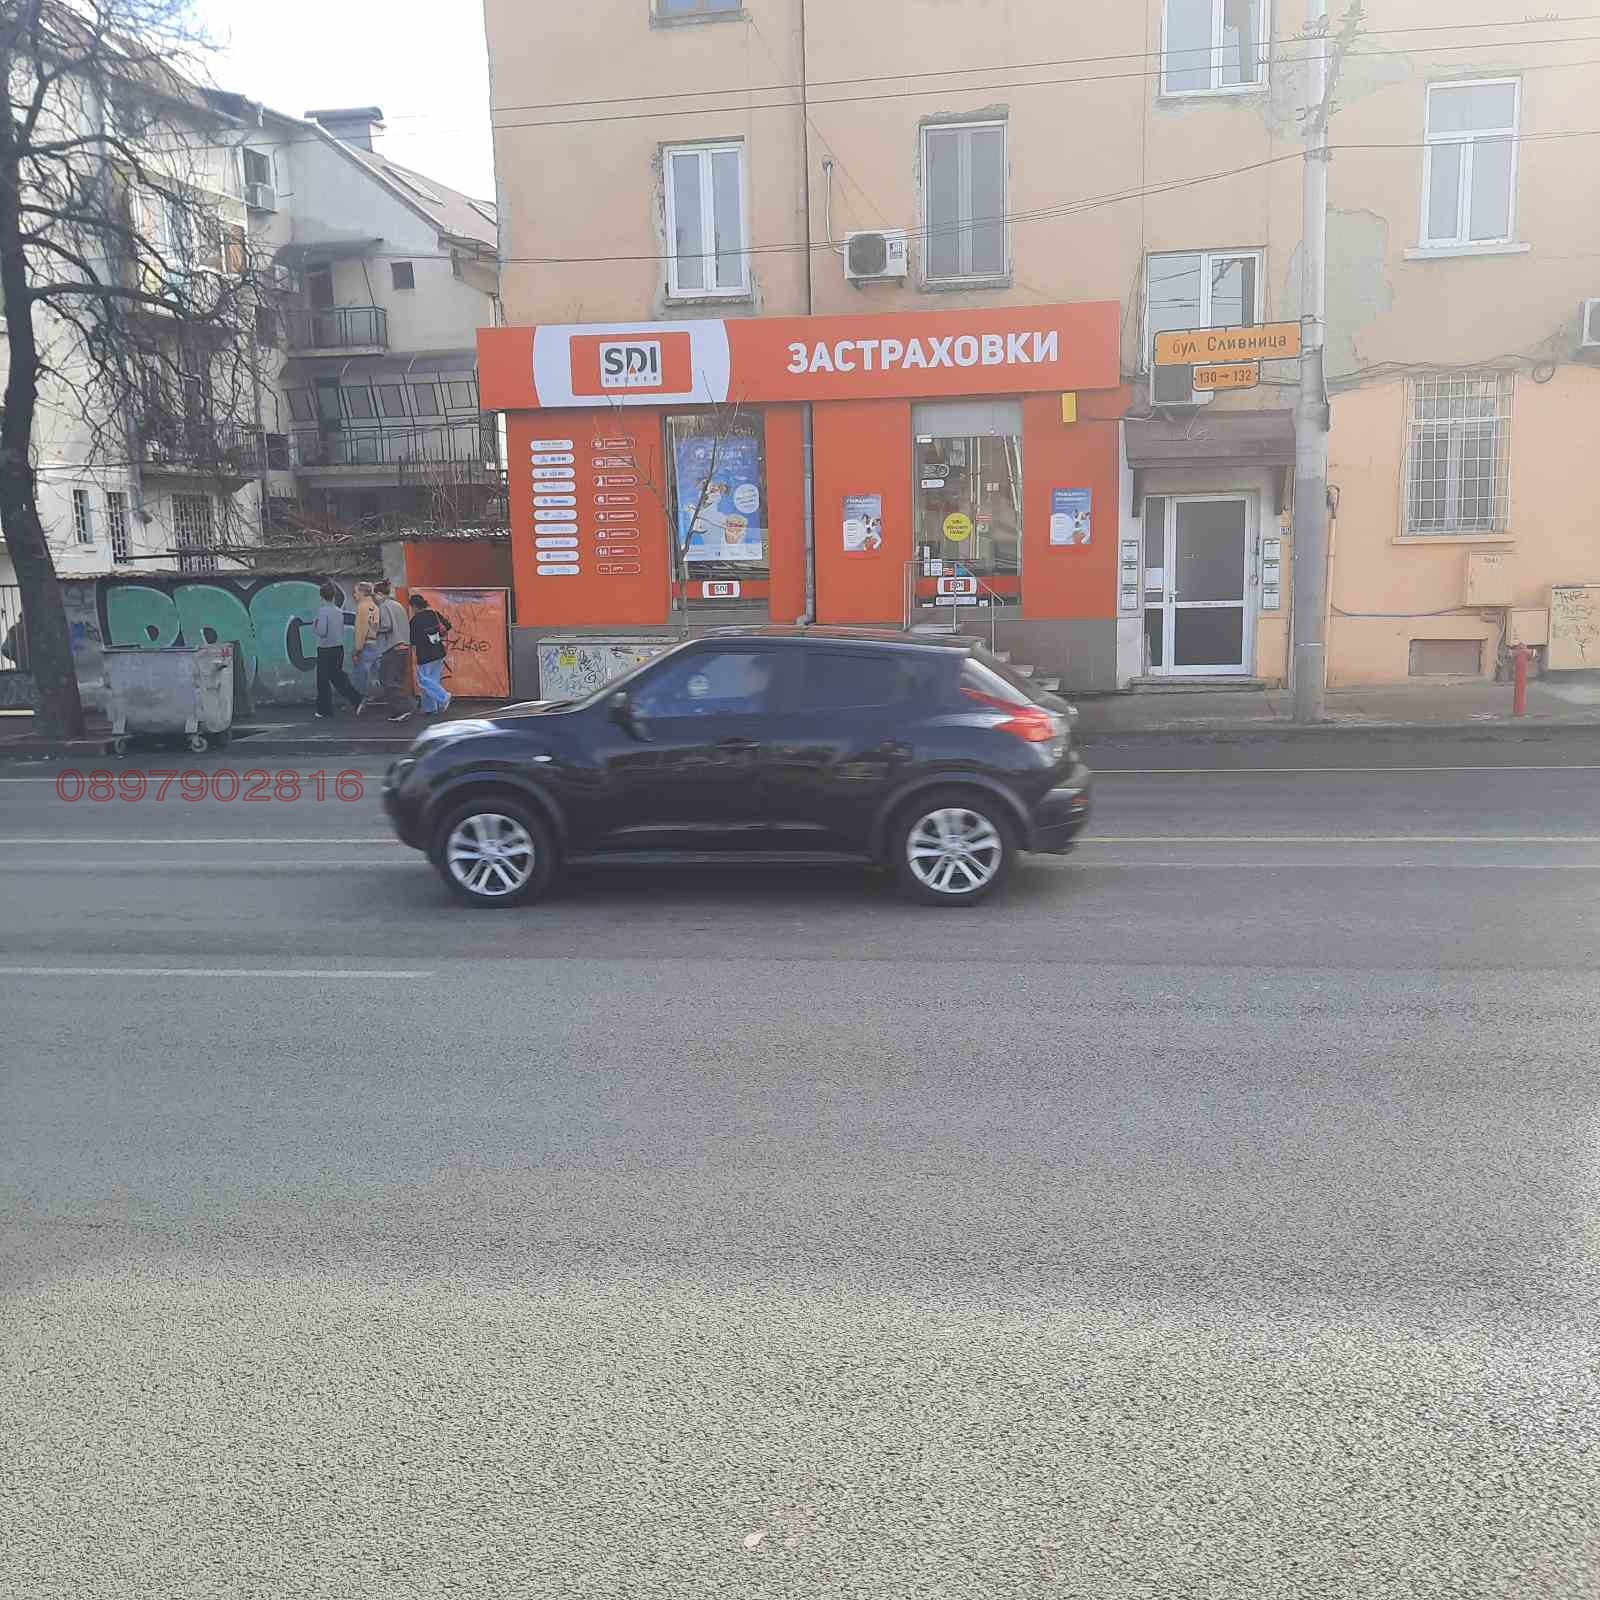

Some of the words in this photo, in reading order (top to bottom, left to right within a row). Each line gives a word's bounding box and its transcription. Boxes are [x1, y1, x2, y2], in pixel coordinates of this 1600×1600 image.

[787, 330, 1058, 374] ЗАСТРАХОВКИ
[1207, 334, 1288, 353] Сливница
[605, 347, 657, 375] SDI
[1200, 371, 1217, 385] 130
[1233, 369, 1253, 383] 132
